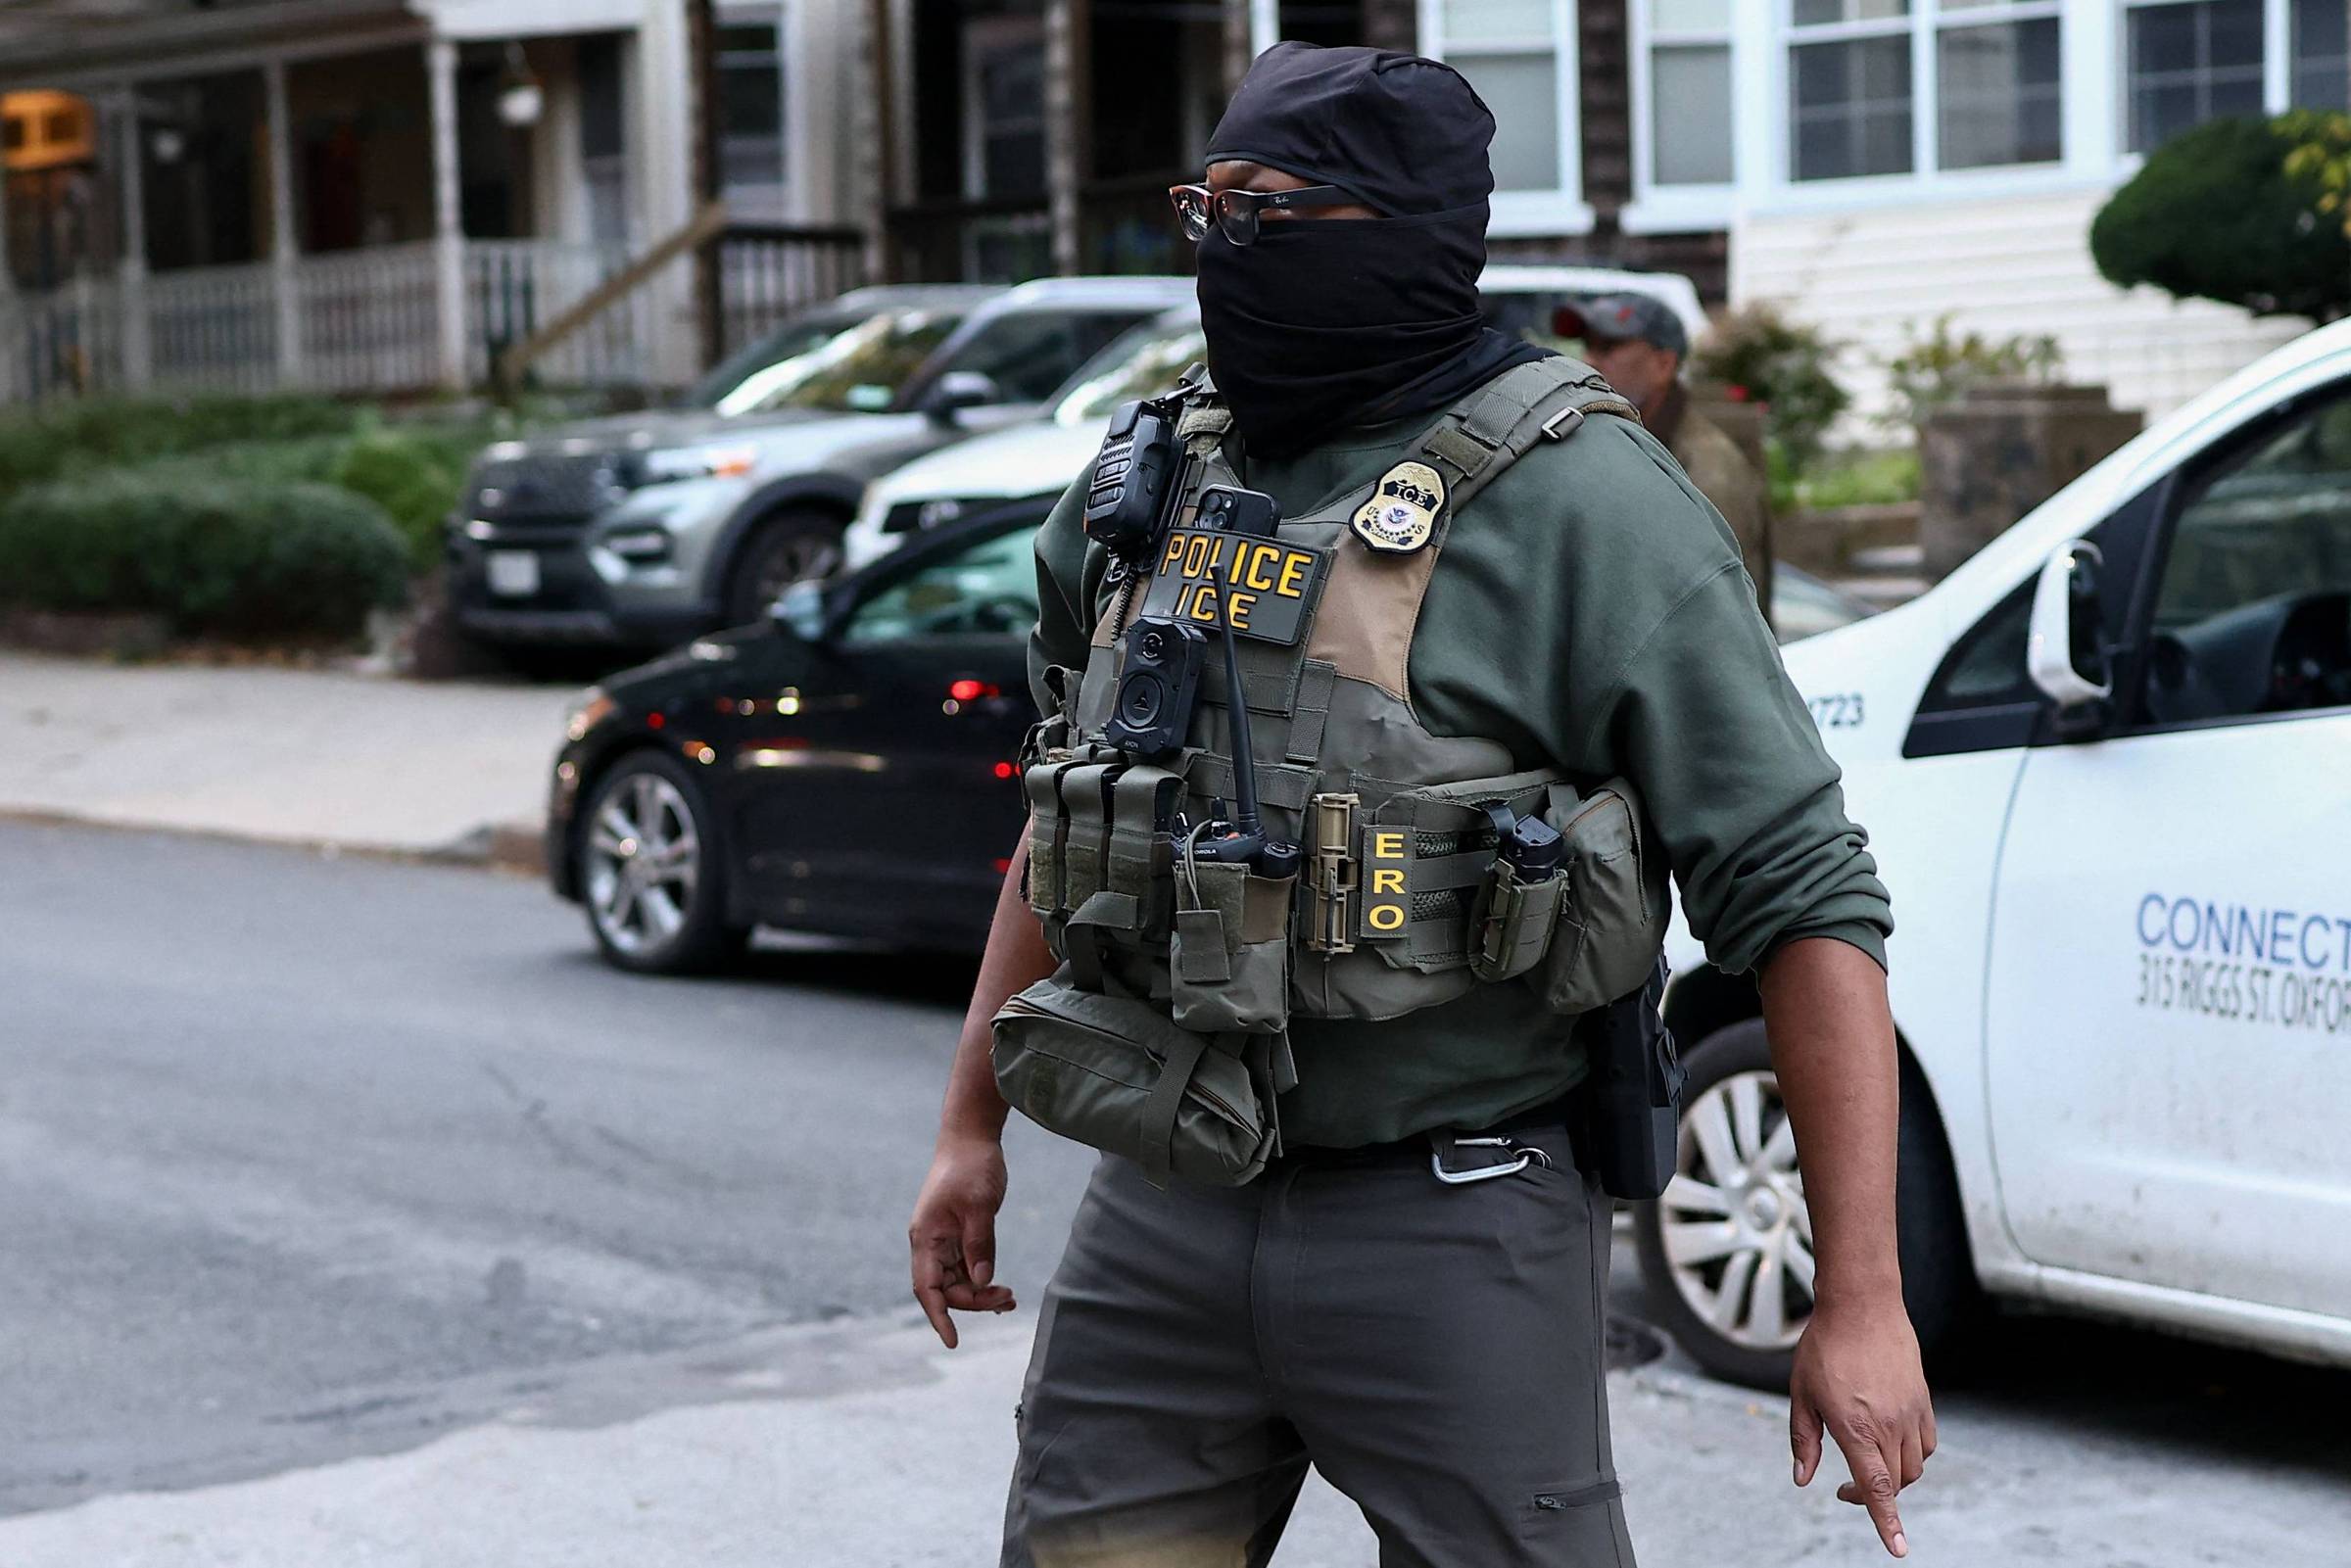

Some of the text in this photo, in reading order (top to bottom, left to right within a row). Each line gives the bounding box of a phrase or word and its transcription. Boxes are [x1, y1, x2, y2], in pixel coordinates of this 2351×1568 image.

[1393, 485, 1428, 506] ICE
[1159, 534, 1313, 598] POLICE
[1175, 584, 1257, 630] ICE
[1368, 832, 1407, 930] ERO
[2137, 953, 2174, 1008] 315
